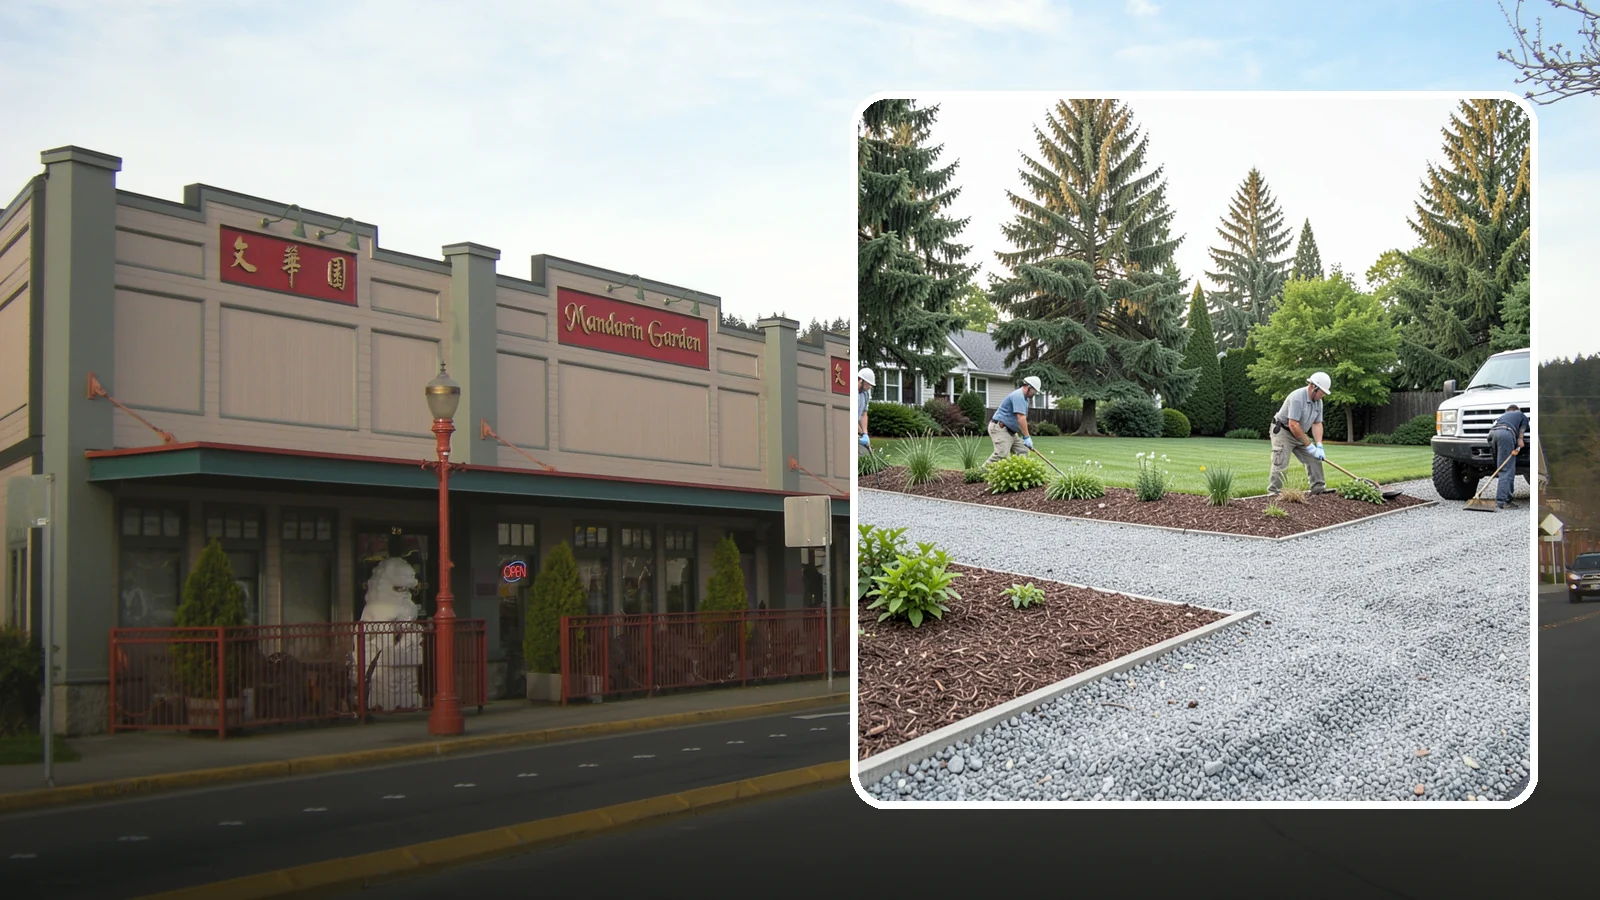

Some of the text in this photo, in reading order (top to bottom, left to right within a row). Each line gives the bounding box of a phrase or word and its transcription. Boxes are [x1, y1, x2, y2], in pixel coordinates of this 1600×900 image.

[230, 235, 346, 291] 文華園
[564, 302, 701, 352] Mandarin Garden
[503, 565, 527, 578] OPEN
